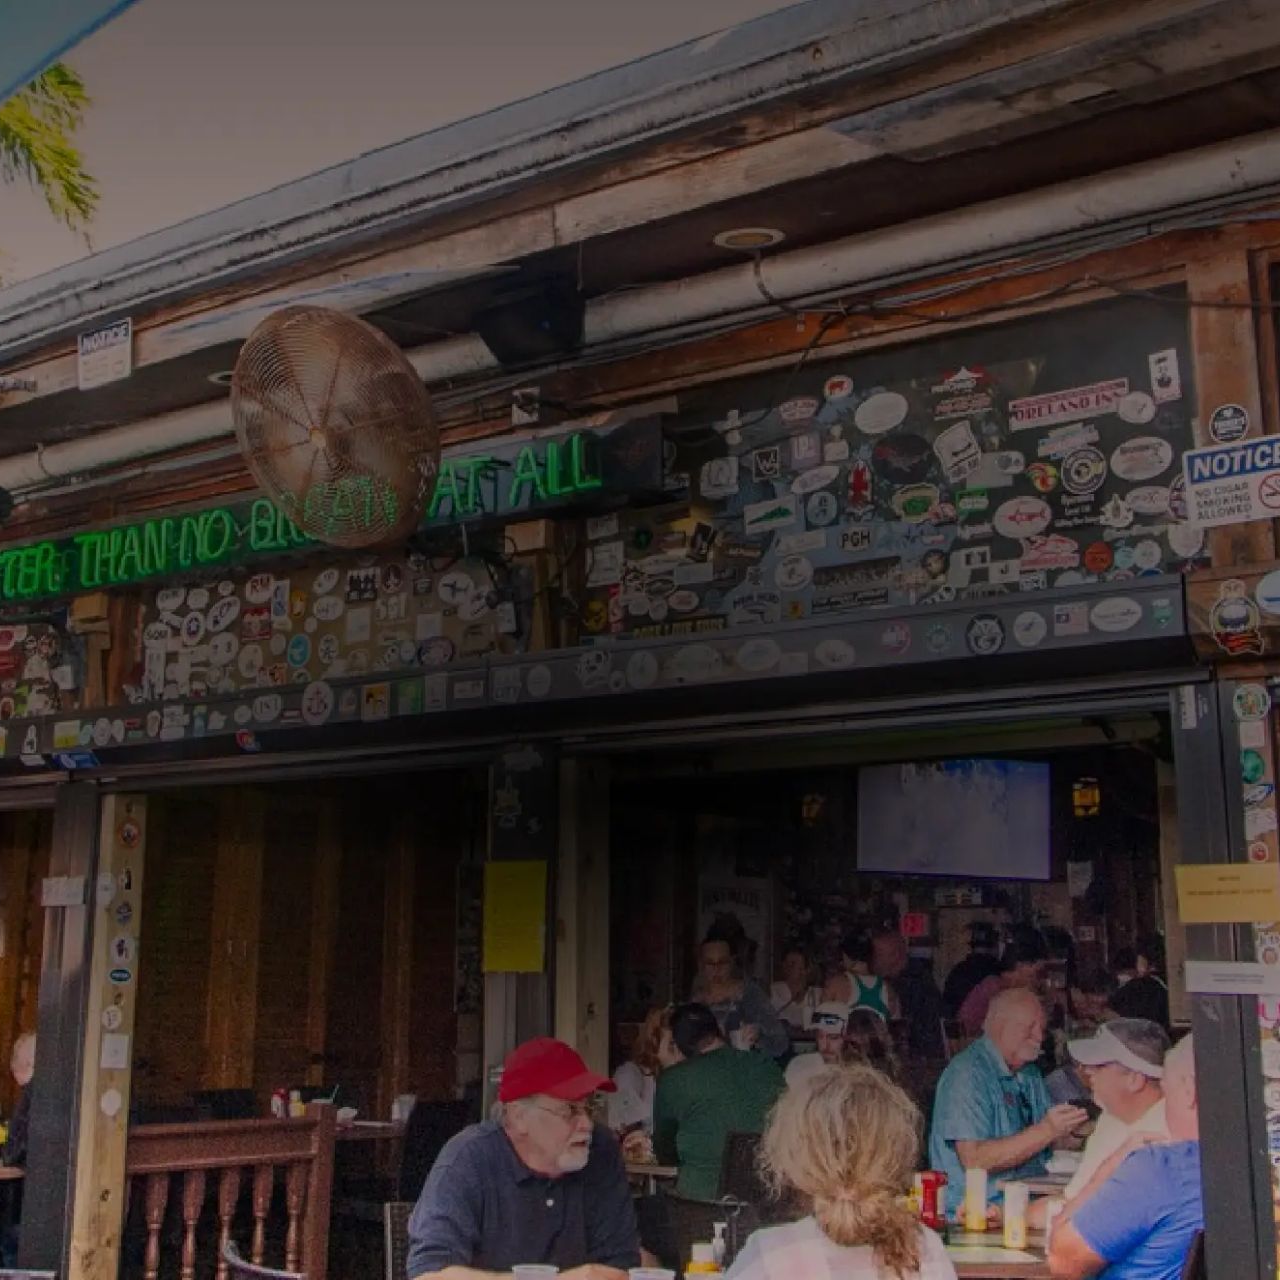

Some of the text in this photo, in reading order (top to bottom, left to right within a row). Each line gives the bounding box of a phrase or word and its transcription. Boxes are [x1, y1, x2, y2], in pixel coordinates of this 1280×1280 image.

[1195, 481, 1249, 497] NO CIGAR
[73, 517, 171, 586] THAN
[177, 509, 232, 568] NO
[426, 456, 495, 519] AT
[510, 433, 603, 506] ALL
[1196, 494, 1251, 508] SMOKING
[1198, 503, 1253, 520] ALLOWED
[841, 530, 871, 548] PGH
